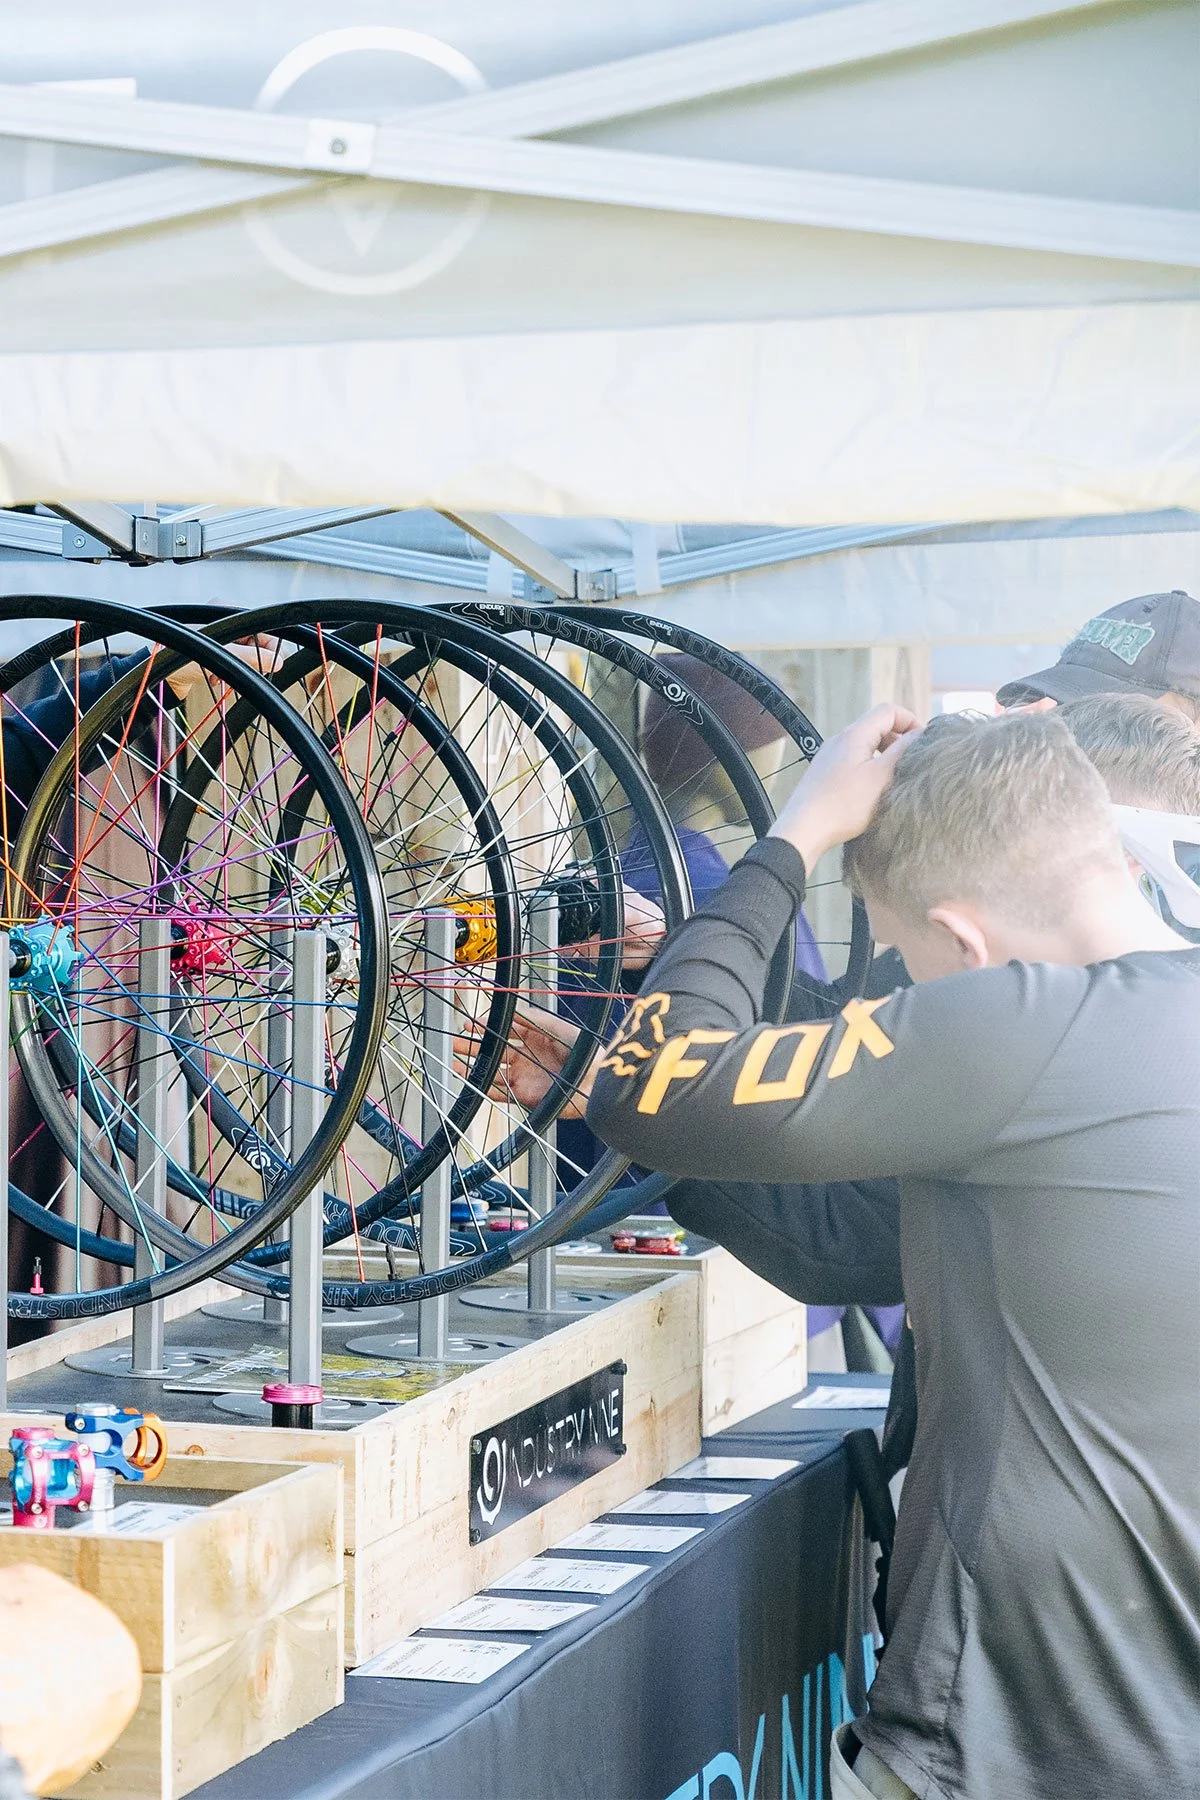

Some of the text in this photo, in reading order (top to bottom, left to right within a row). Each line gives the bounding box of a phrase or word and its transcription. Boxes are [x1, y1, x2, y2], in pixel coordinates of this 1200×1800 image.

[504, 605, 615, 653] INDUSTRY
[614, 644, 669, 690] NINE
[669, 627, 768, 696] INDUSTRY
[763, 690, 808, 737] NINE
[638, 995, 894, 1114] FOX
[363, 1260, 485, 1306] INDUSTRY
